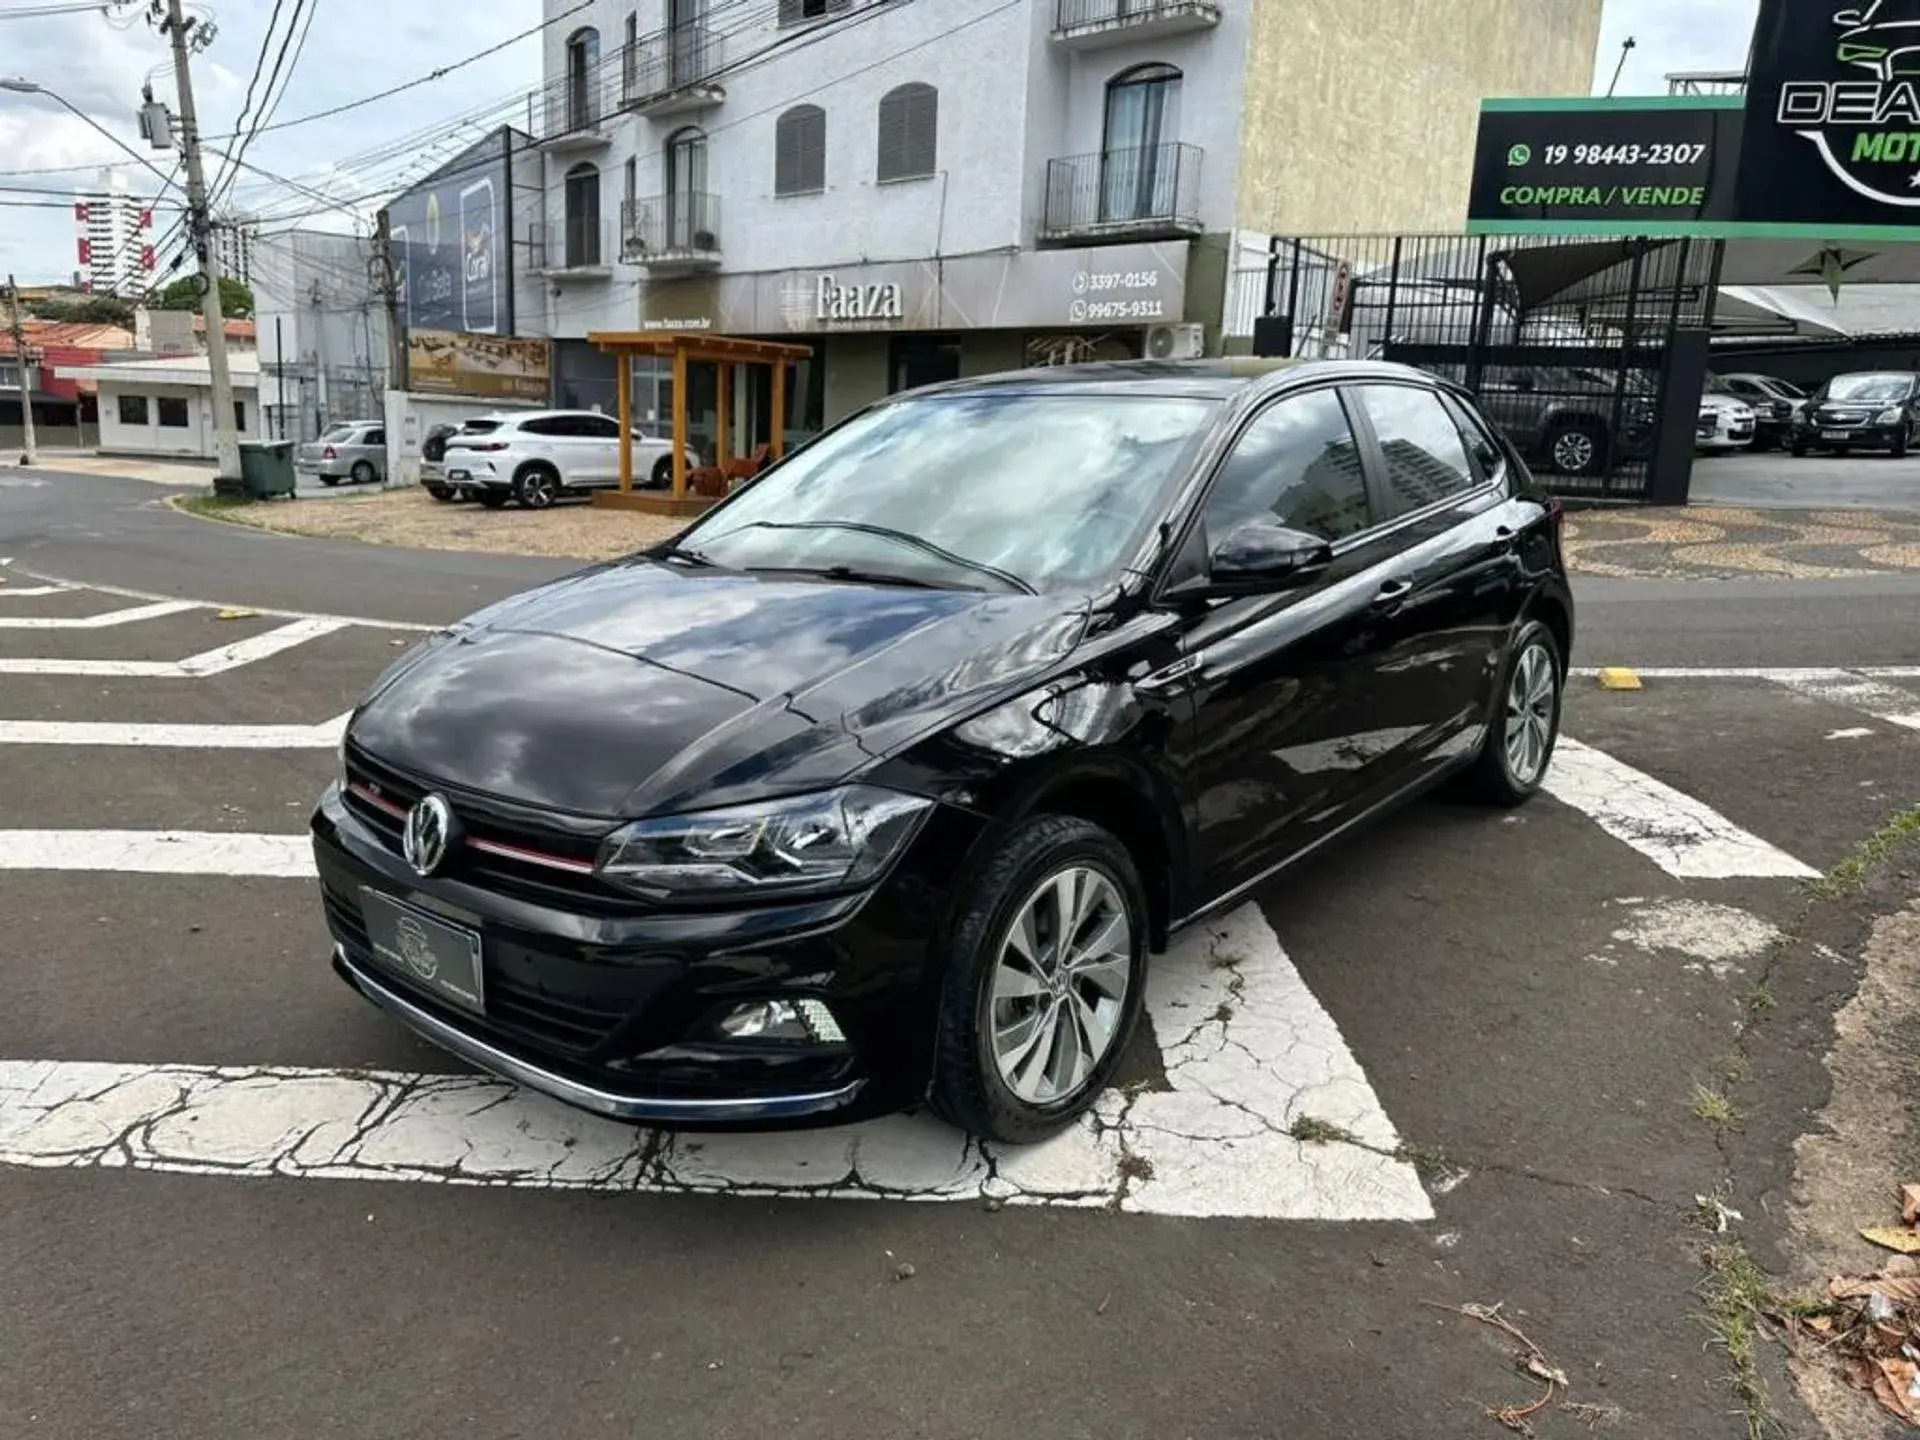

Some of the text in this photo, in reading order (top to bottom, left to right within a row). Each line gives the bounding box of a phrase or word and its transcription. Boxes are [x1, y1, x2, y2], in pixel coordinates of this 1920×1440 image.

[1776, 81, 1920, 124] DEA
[1544, 144, 1706, 165] 19 98443-2307
[1500, 186, 1601, 205] COMPRA
[1621, 186, 1706, 206] VENDE
[817, 273, 903, 319] Faaza
